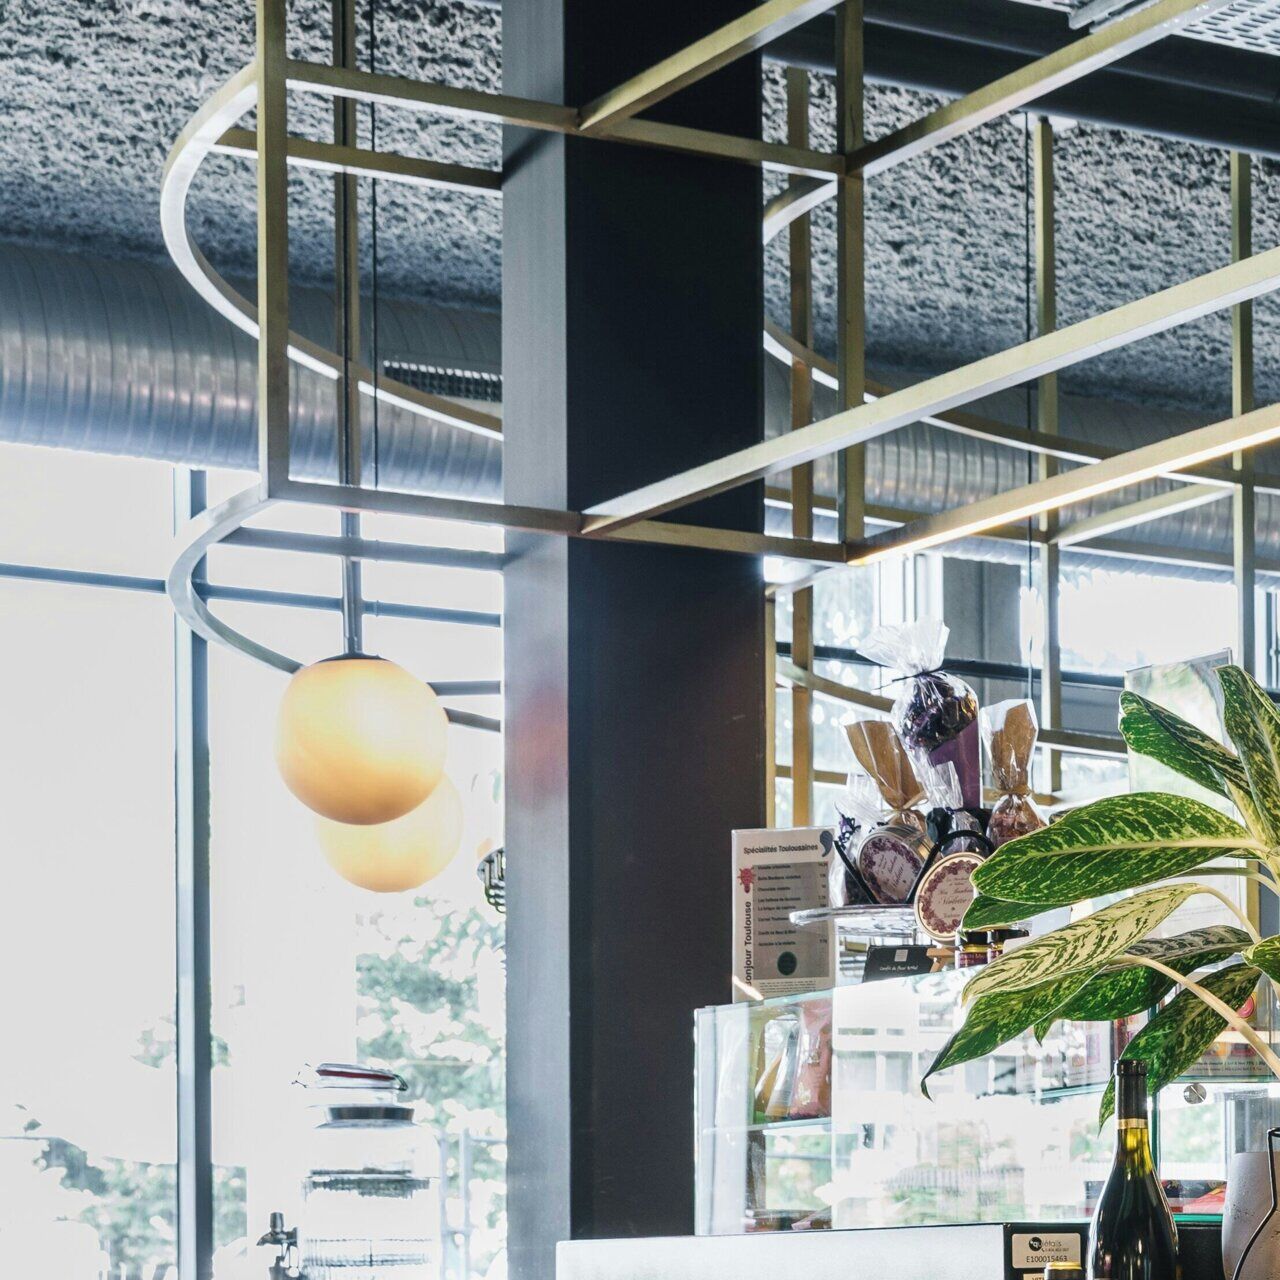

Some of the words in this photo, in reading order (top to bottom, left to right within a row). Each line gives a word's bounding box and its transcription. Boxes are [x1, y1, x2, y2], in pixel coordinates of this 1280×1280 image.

[743, 845, 778, 855] Spécialités
[778, 843, 819, 852] Toulousaines
[744, 901, 752, 947] Toulouse
